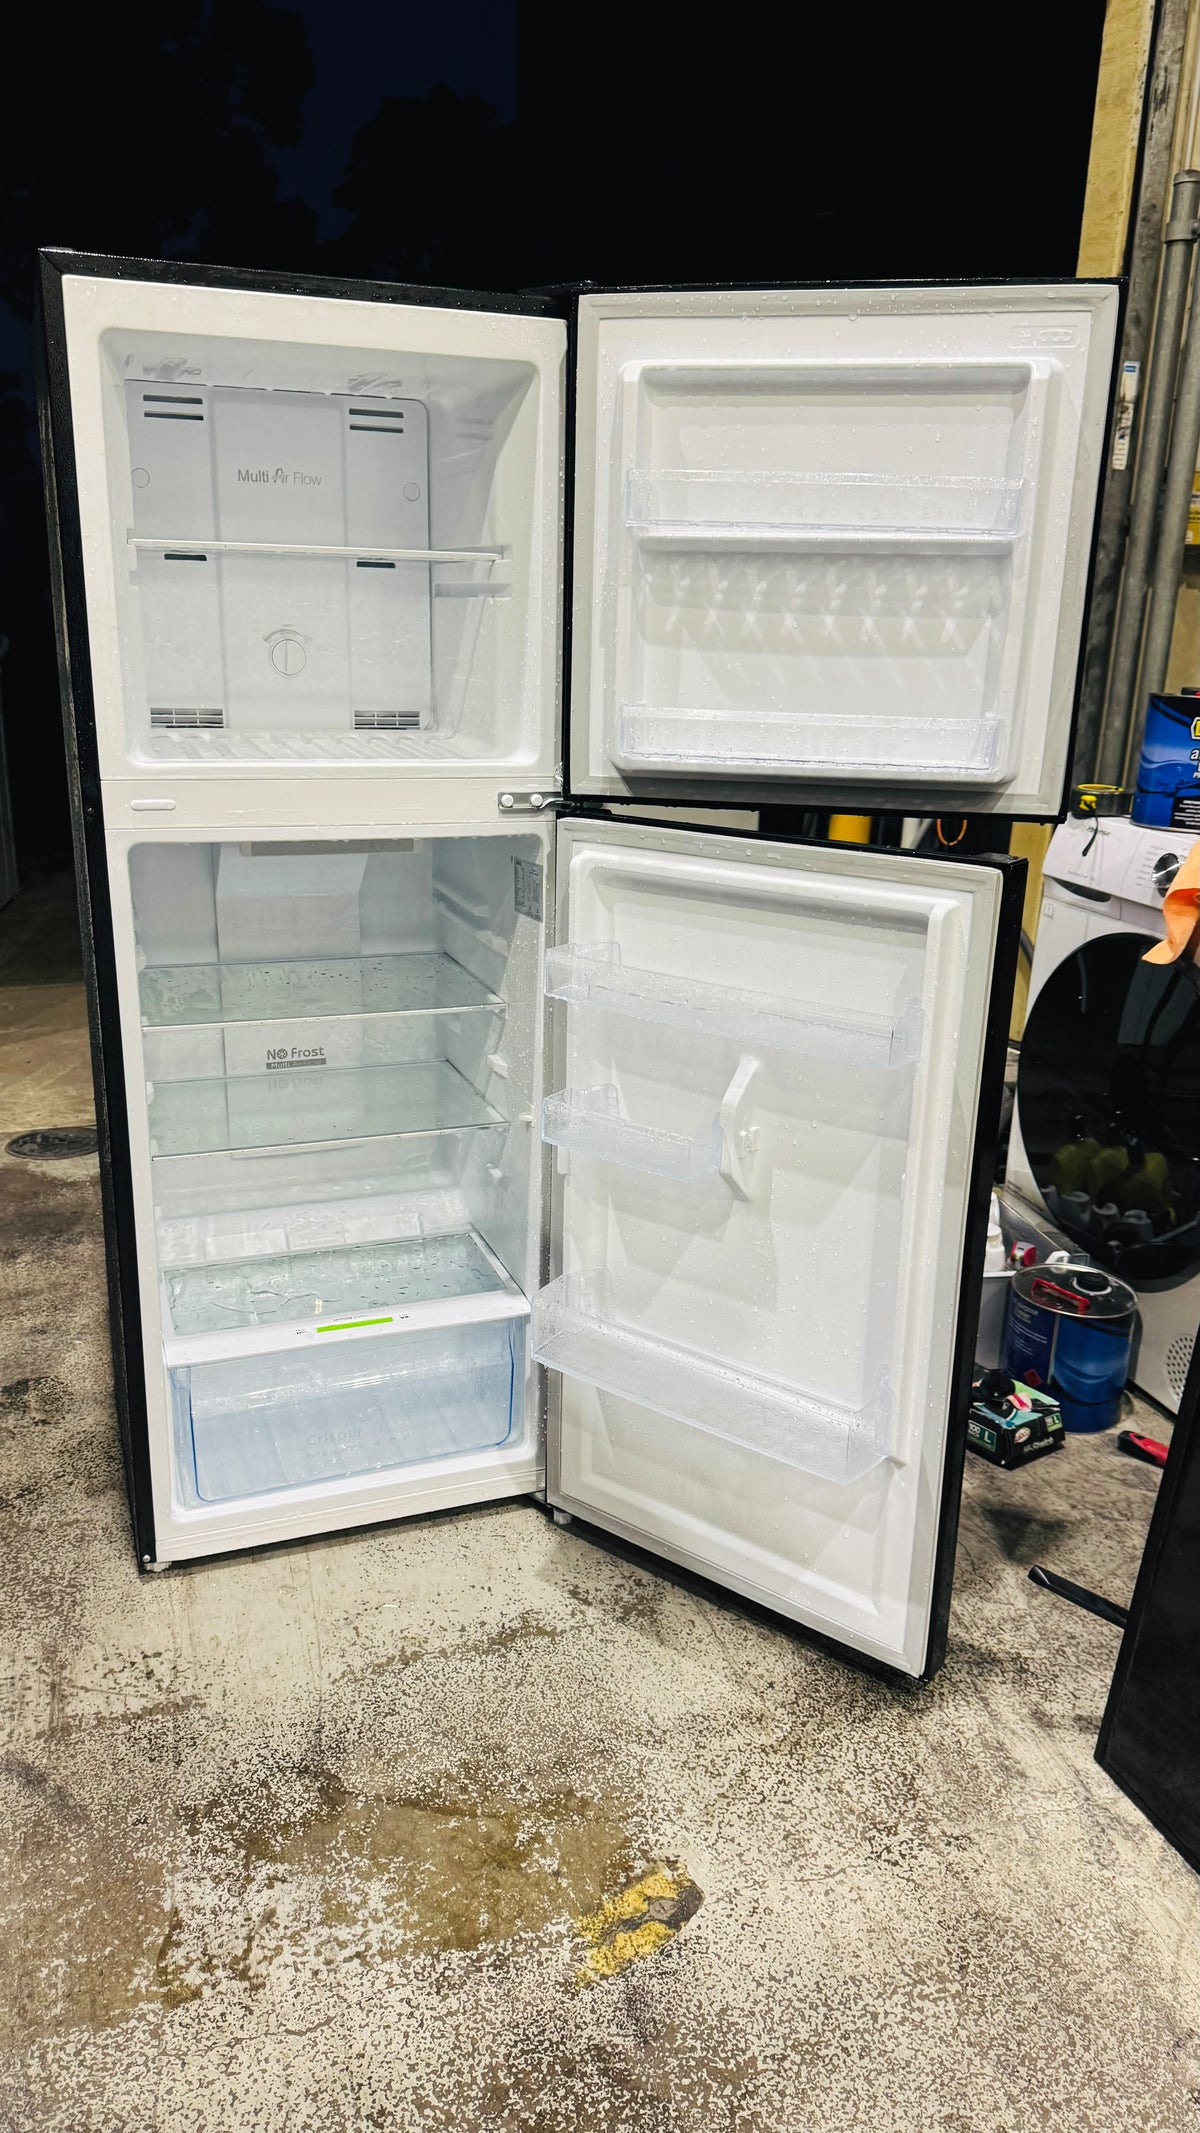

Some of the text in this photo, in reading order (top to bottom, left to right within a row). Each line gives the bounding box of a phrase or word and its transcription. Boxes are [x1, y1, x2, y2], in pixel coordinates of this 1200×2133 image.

[237, 469, 269, 483] Multi
[293, 472, 321, 486] Flow
[267, 1048, 288, 1060] NO
[984, 1431, 991, 1443] L
